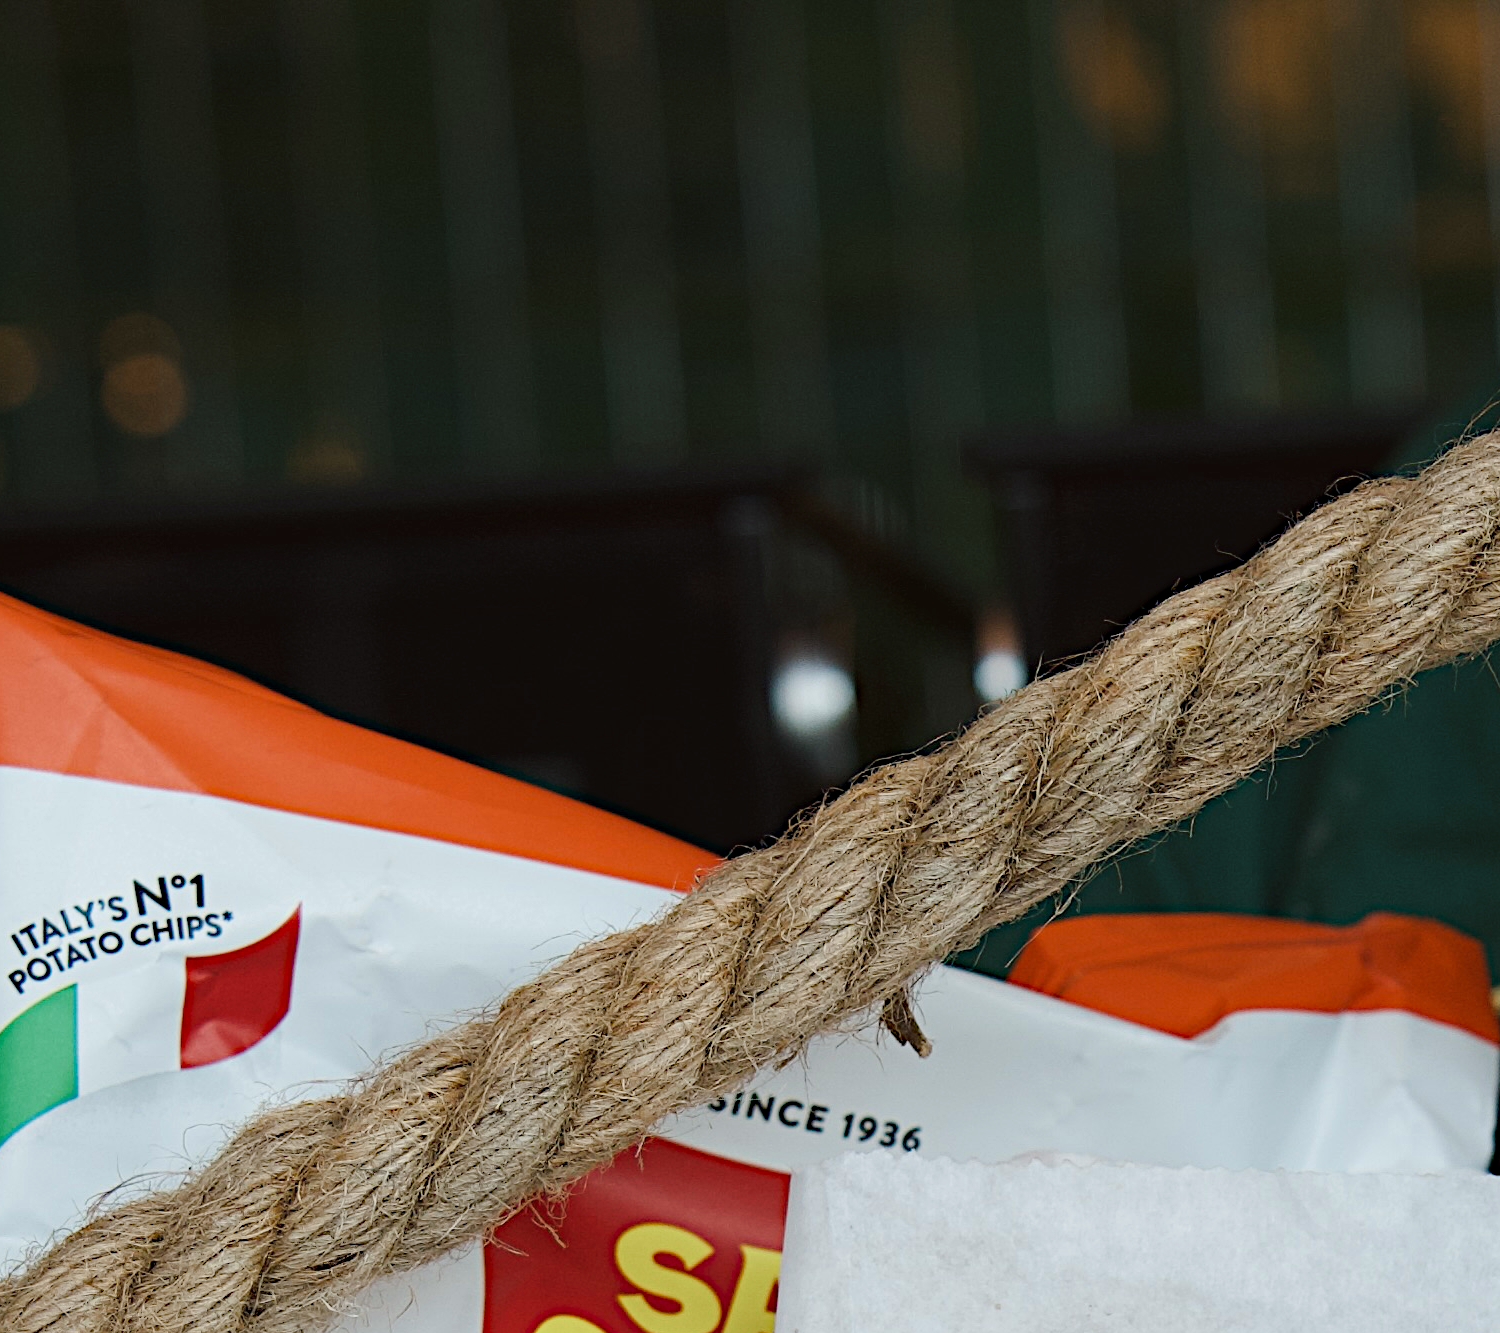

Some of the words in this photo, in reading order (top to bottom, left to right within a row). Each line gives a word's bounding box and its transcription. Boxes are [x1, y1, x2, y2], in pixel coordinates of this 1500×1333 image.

[10, 895, 128, 956] ITALY'S
[8, 930, 124, 995] POTATO
[707, 1091, 830, 1133] SINCE
[842, 1112, 924, 1152] 1936
